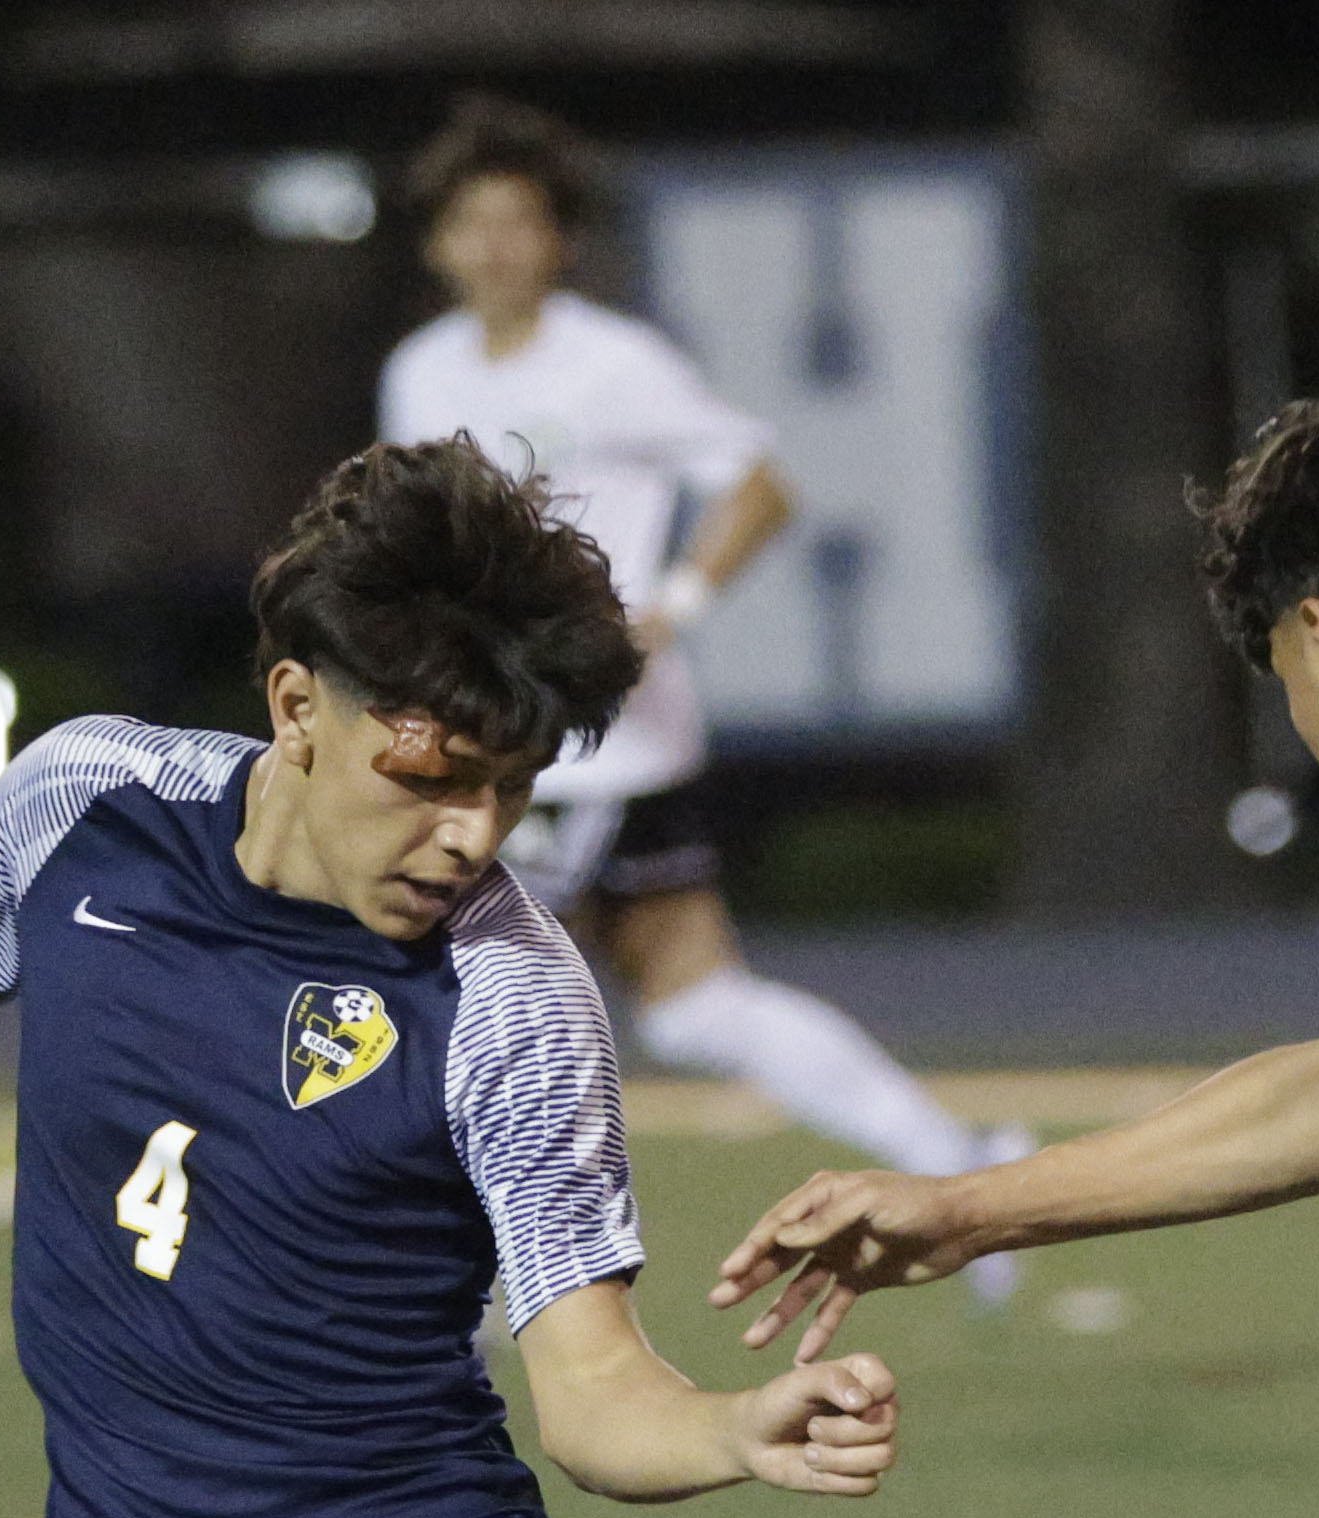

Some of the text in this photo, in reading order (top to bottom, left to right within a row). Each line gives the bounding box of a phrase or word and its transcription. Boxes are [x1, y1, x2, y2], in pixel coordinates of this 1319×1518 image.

[655, 180, 1015, 715] H
[307, 1035, 346, 1061] RAMS
[116, 1120, 198, 1281] 4
